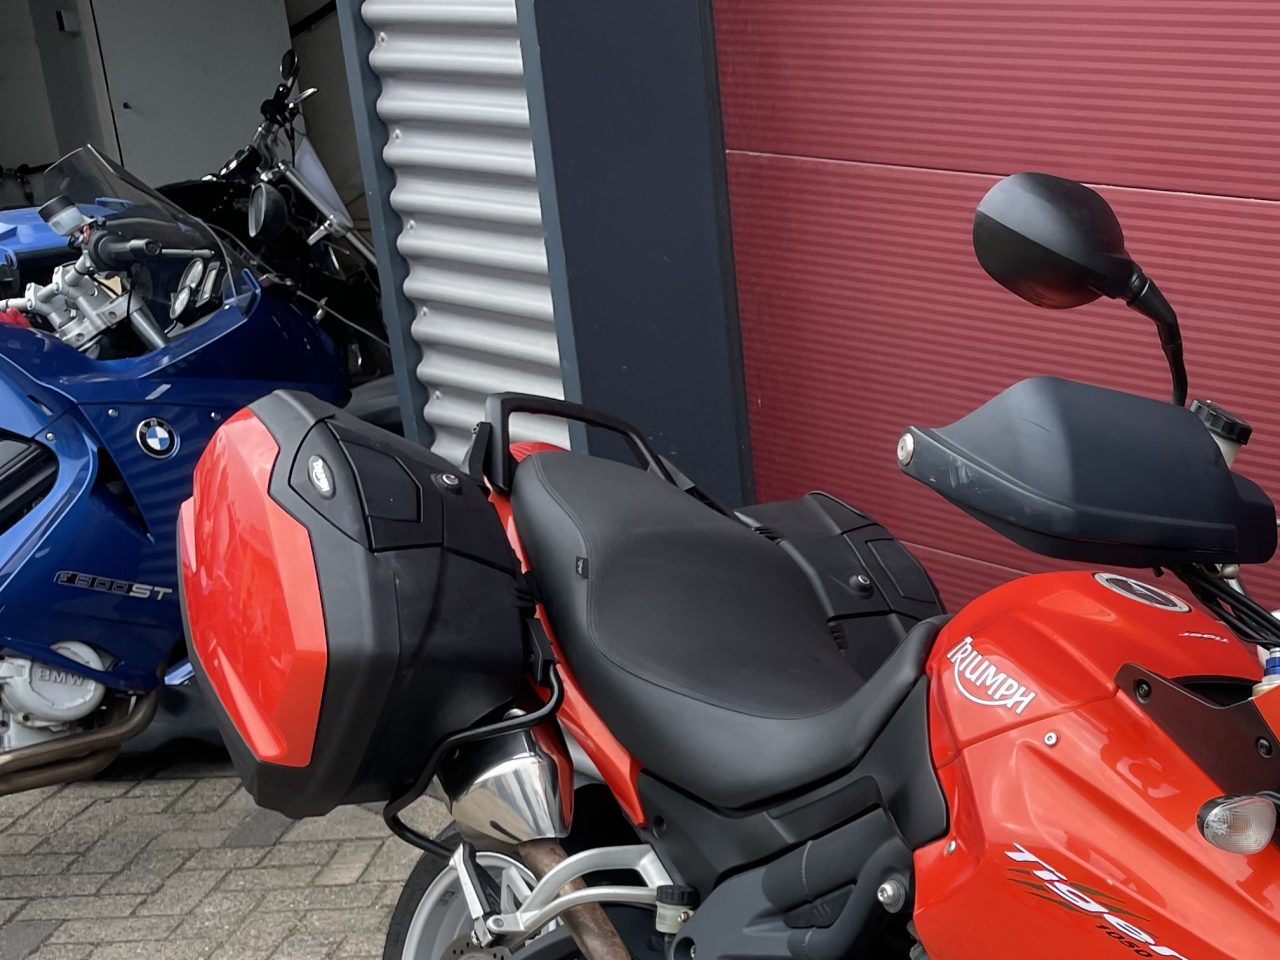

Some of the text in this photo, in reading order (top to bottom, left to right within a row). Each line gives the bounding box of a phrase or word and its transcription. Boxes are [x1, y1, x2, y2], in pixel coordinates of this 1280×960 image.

[39, 667, 85, 687] BMW
[947, 636, 1036, 714] TRIUMPH
[1095, 924, 1153, 958] 1050
